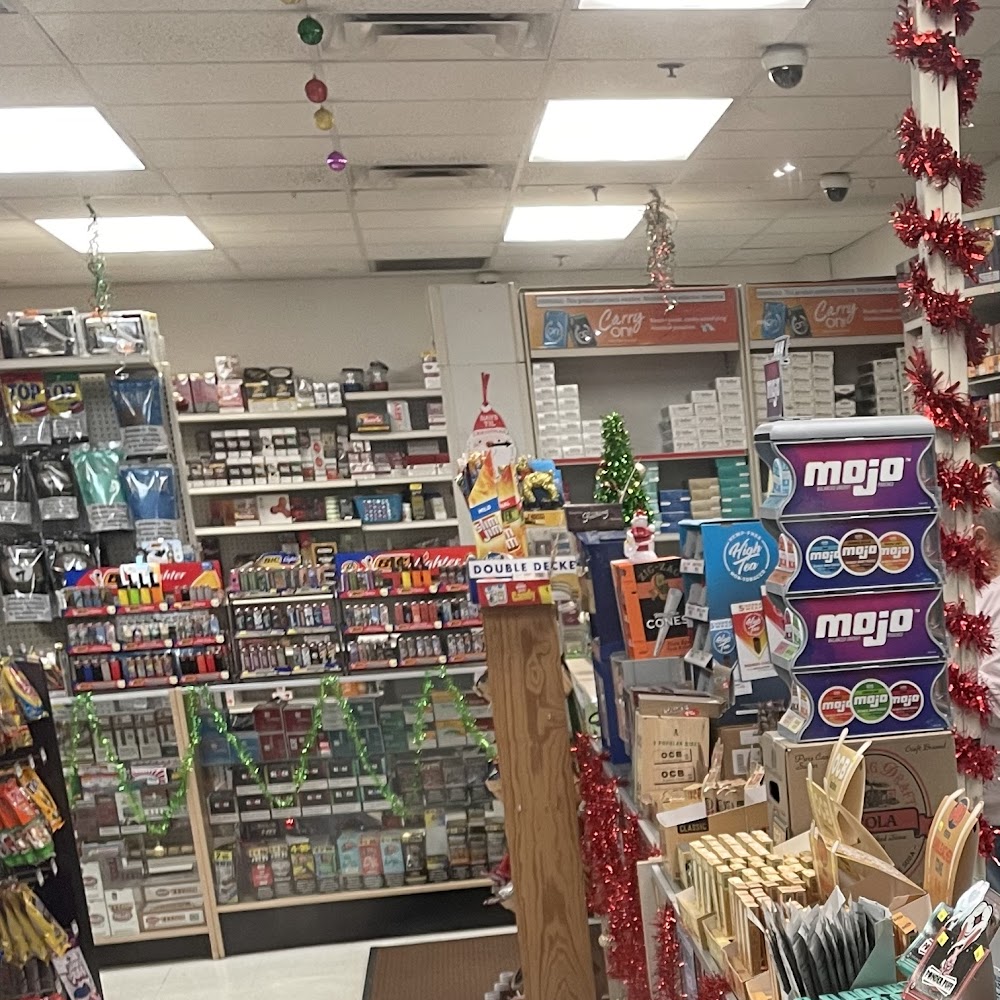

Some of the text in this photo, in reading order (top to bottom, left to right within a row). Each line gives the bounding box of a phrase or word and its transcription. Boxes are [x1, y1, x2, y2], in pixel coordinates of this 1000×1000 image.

[600, 309, 645, 333] Carry
[9, 381, 39, 400] TOP
[803, 456, 904, 497] mojo
[729, 538, 762, 560] High
[842, 544, 878, 560] mojo
[473, 563, 527, 575] DOUBLE
[733, 556, 759, 576] Tea
[646, 615, 688, 630] CONES
[815, 608, 914, 647] mojo
[854, 694, 889, 709] mojo
[892, 693, 920, 707] mojo
[661, 751, 683, 760] OCB
[661, 770, 685, 779] OCB
[831, 754, 850, 780] OCB
[866, 814, 898, 829] OLA
